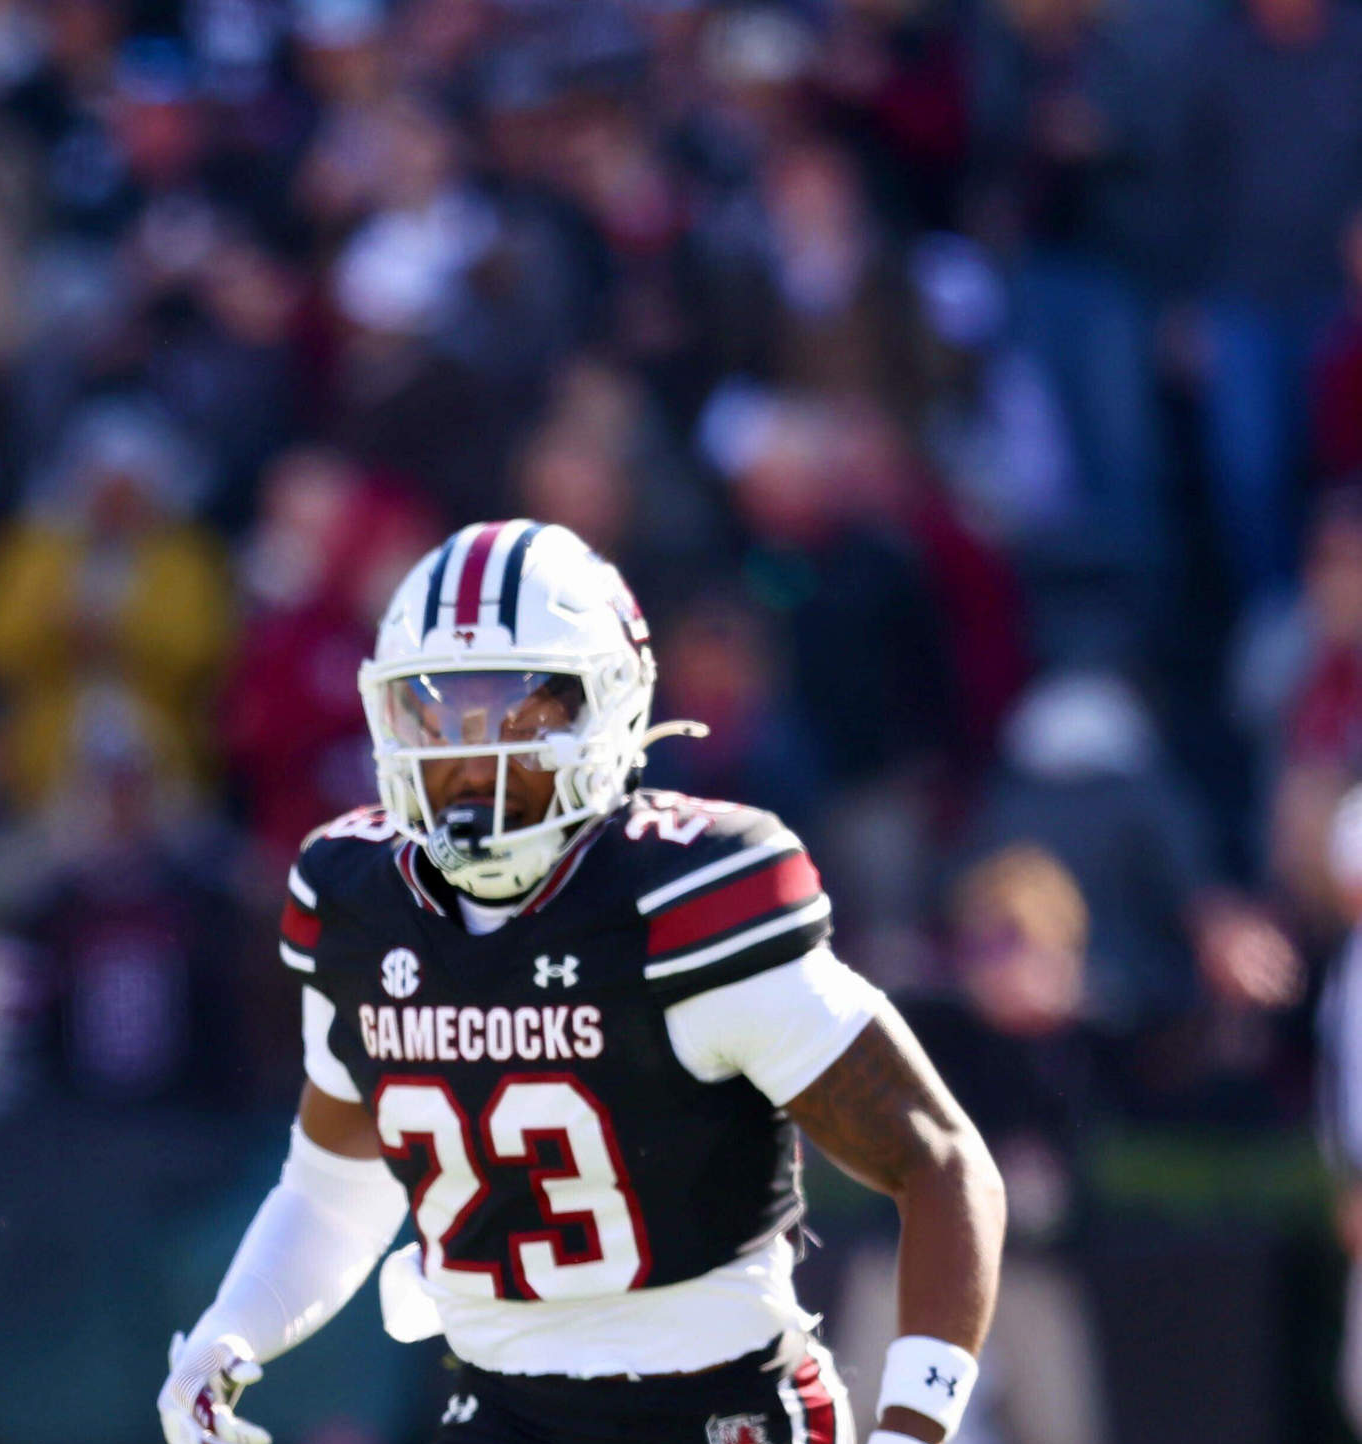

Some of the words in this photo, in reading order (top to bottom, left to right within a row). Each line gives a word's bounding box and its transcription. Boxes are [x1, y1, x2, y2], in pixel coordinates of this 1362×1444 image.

[380, 947, 420, 998] SEC
[359, 1005, 604, 1061] GAMECOCKS
[376, 1073, 652, 1302] 23
